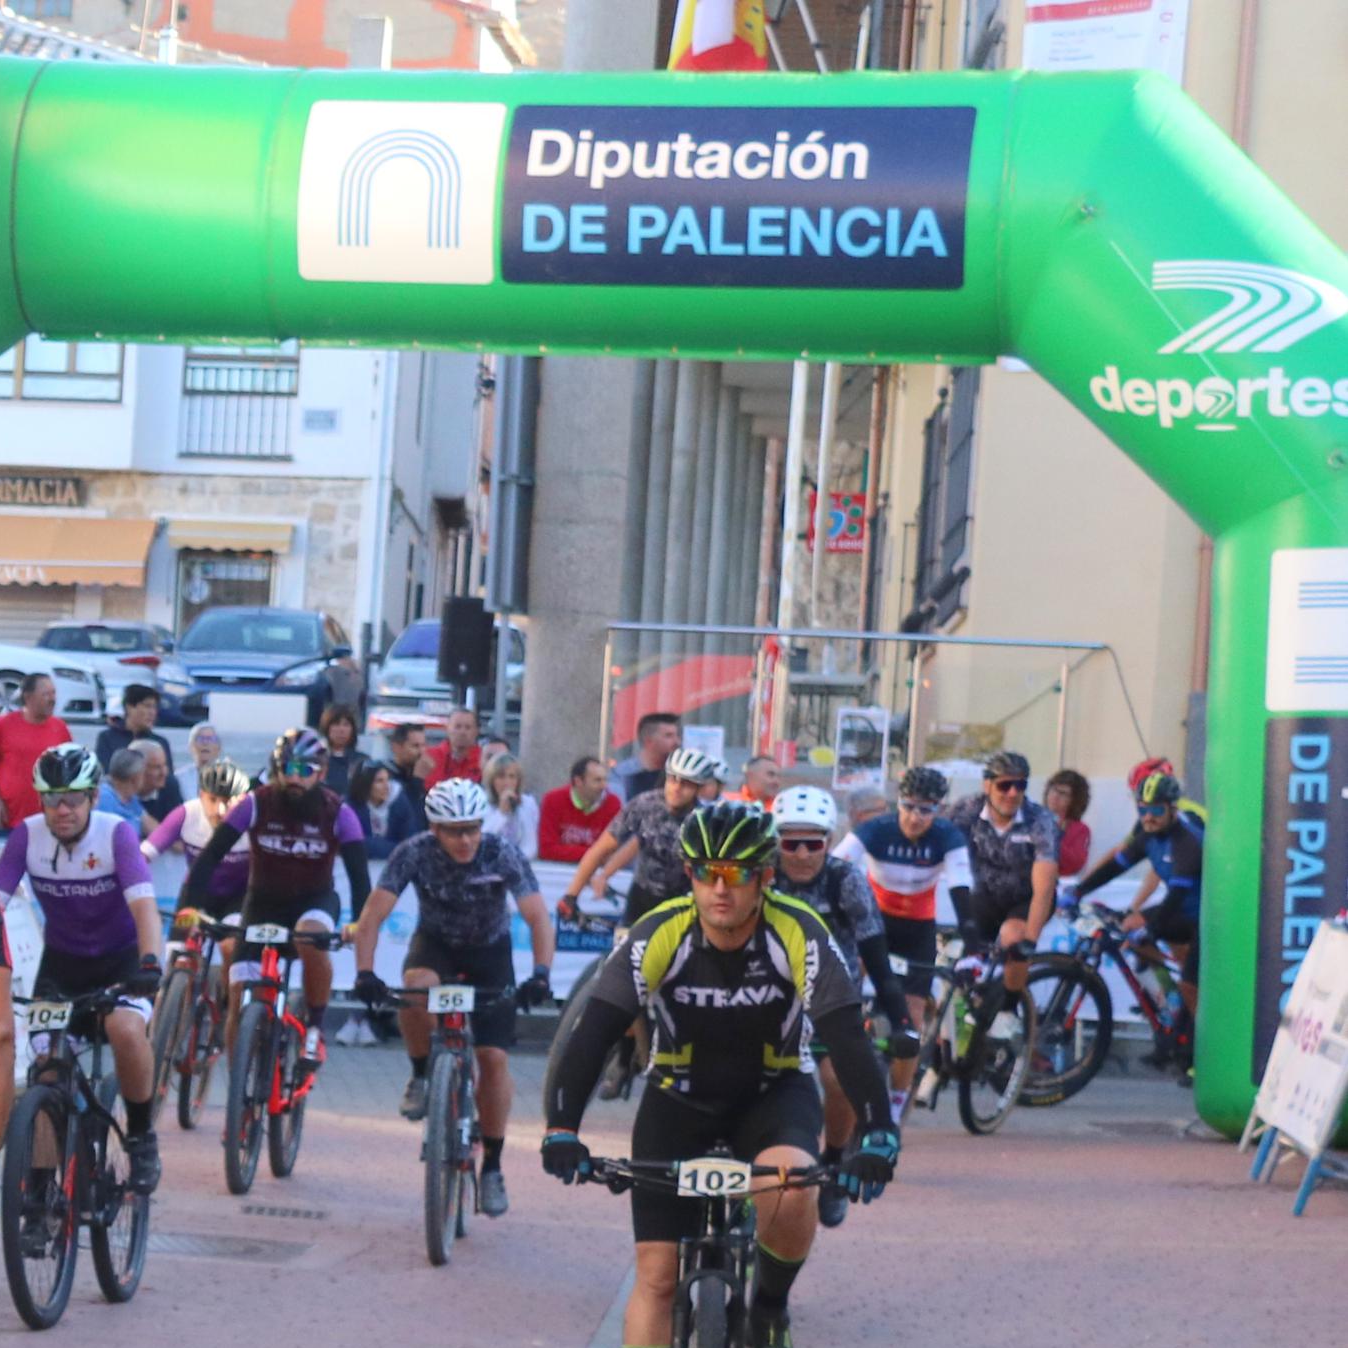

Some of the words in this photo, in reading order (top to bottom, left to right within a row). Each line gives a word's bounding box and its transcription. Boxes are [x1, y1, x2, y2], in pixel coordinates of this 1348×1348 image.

[526, 129, 870, 189] Diputación
[522, 204, 608, 254] DE
[628, 206, 949, 258] PALENCIA
[1289, 733, 1331, 804] DE
[255, 927, 279, 938] 29
[437, 992, 464, 1009] 56
[673, 984, 786, 1008] STRAVA
[26, 1009, 66, 1026] 104
[684, 1170, 746, 1190] 102
